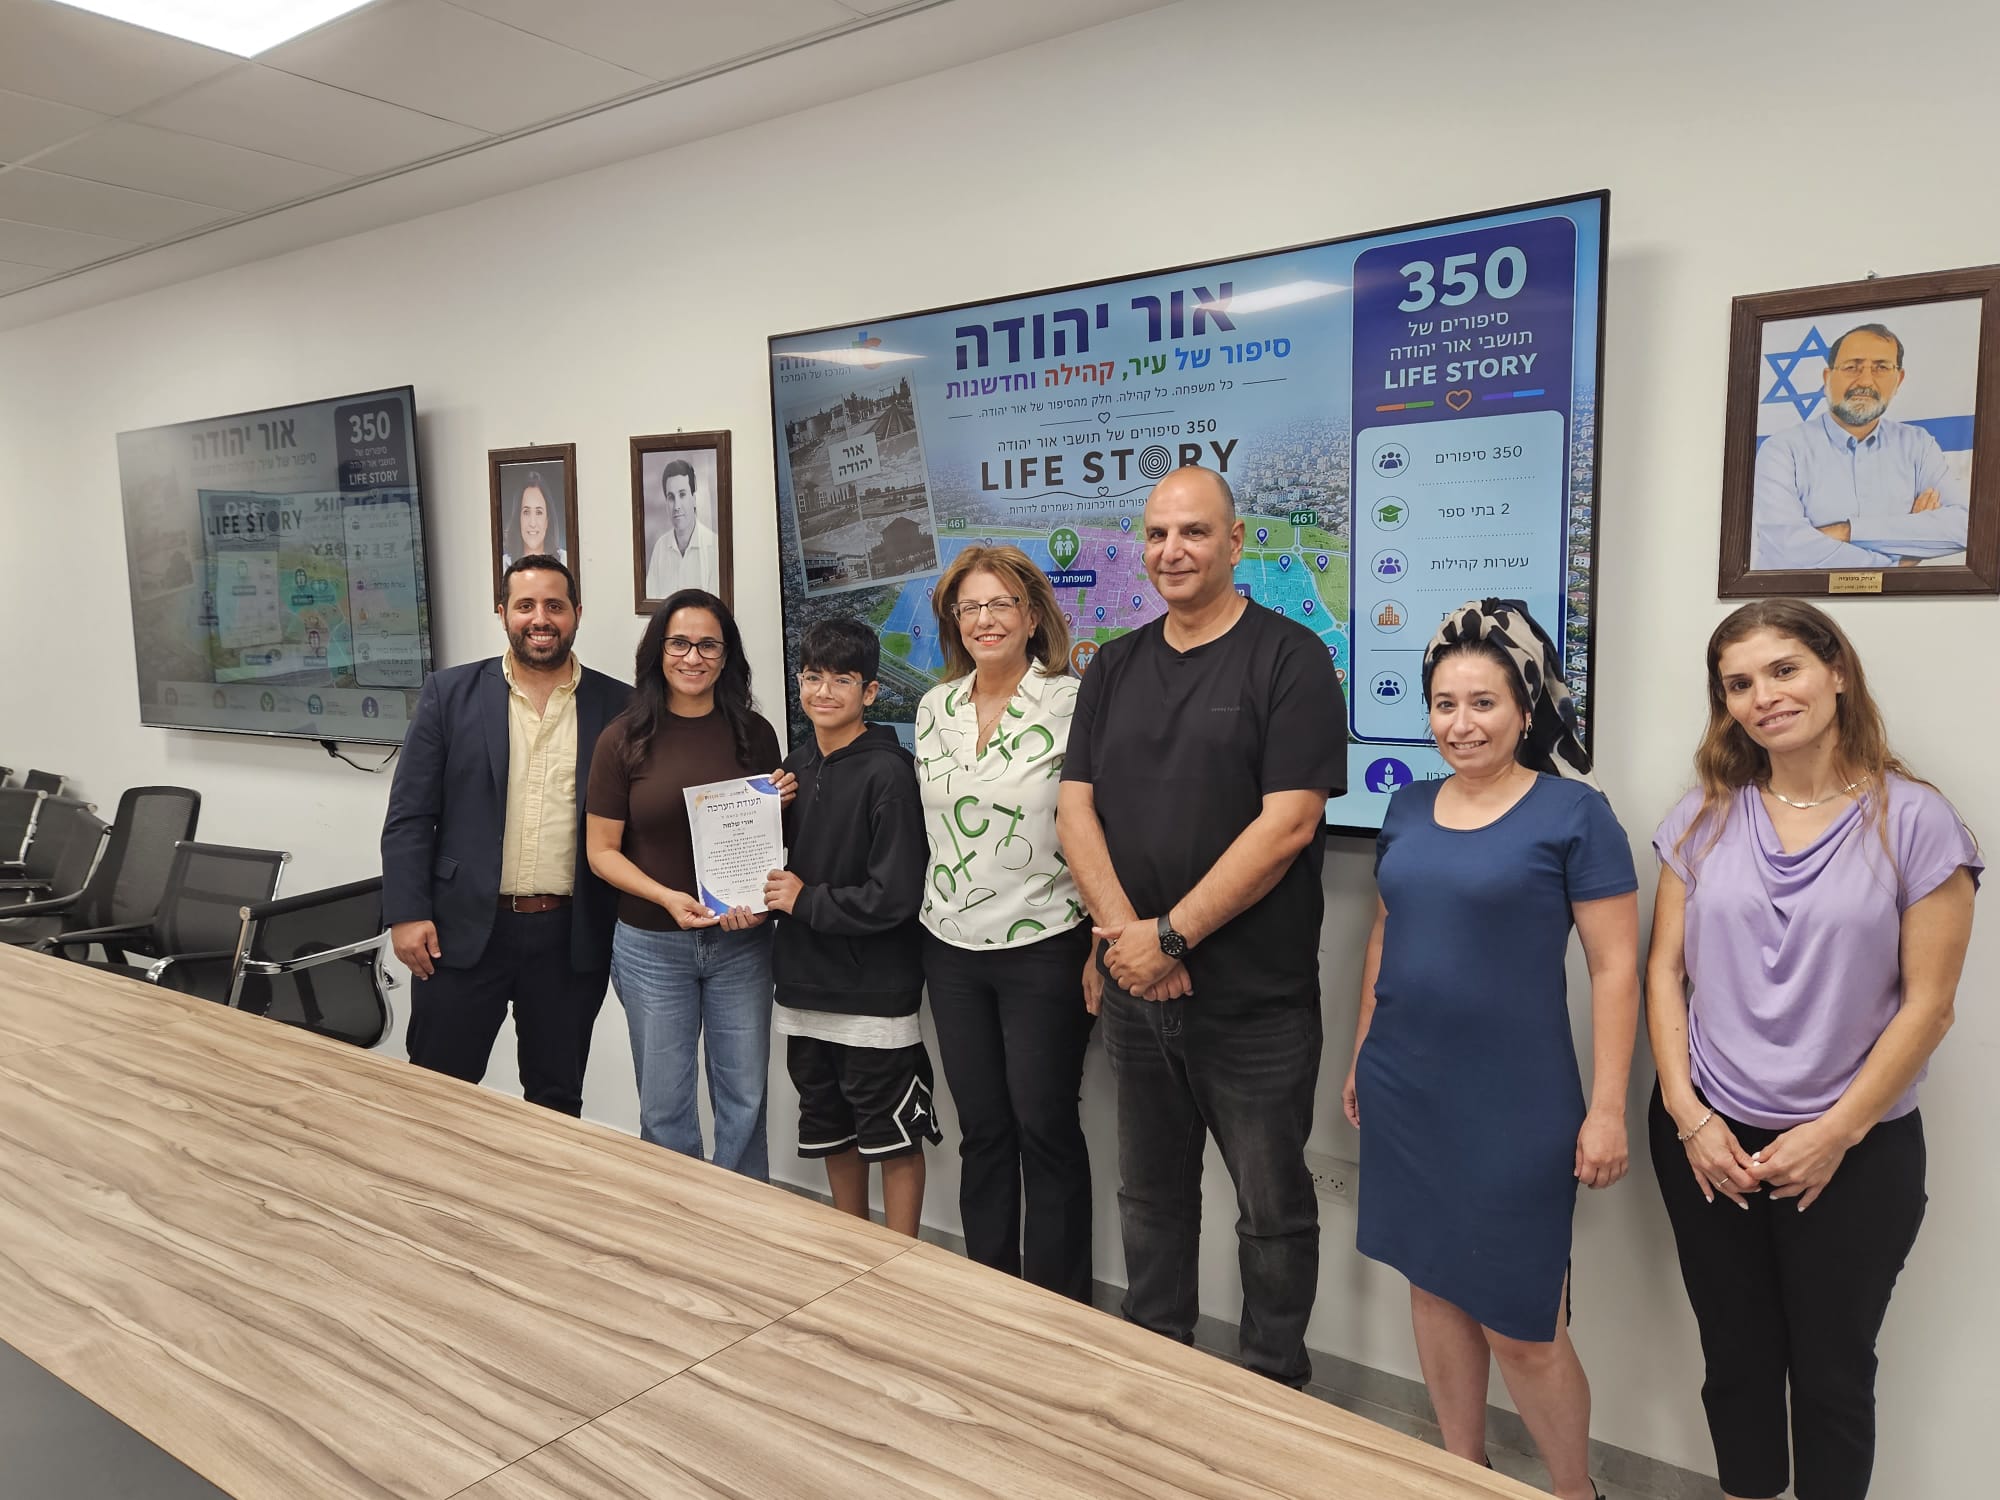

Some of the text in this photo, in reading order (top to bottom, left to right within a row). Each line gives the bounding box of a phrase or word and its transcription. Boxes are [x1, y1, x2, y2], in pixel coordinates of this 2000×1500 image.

[1397, 246, 1527, 312] 350
[955, 281, 1236, 371] אור יהודה
[1408, 312, 1509, 336] סיפורים של
[1390, 330, 1532, 360] תושבי אור יהודה
[781, 366, 851, 384] המרכז של המרכז
[946, 338, 1291, 399] סיפור של עיר, קהילה וחדשנות
[1385, 352, 1538, 390] LIFE STORY
[979, 379, 1233, 418] כל משפחה. כל קהילה. חלק מהסיפור של אור יהודה.
[349, 411, 391, 443] 350
[998, 418, 1217, 452] 350 סיפורים של תושבי אור יהודה
[191, 418, 297, 459] אור יהודה
[843, 443, 865, 458] אור
[1435, 445, 1523, 464] 350 סיפורים
[838, 458, 873, 476] יהודה
[981, 438, 1239, 491] LIFE STORY
[349, 470, 399, 486] LIFE STORY
[1041, 502, 1073, 513] נשמרים
[1076, 500, 1115, 511] וזיכרונות
[1119, 498, 1147, 508] יפורים
[1438, 503, 1511, 518] 2 בתי ספר
[207, 510, 303, 536] LIFE STORY
[949, 519, 965, 529] 461
[1292, 513, 1315, 524] 461
[1430, 557, 1529, 571] עשרות קהילות
[1062, 574, 1092, 583] משפחת
[707, 797, 761, 813] תעודת הערכה
